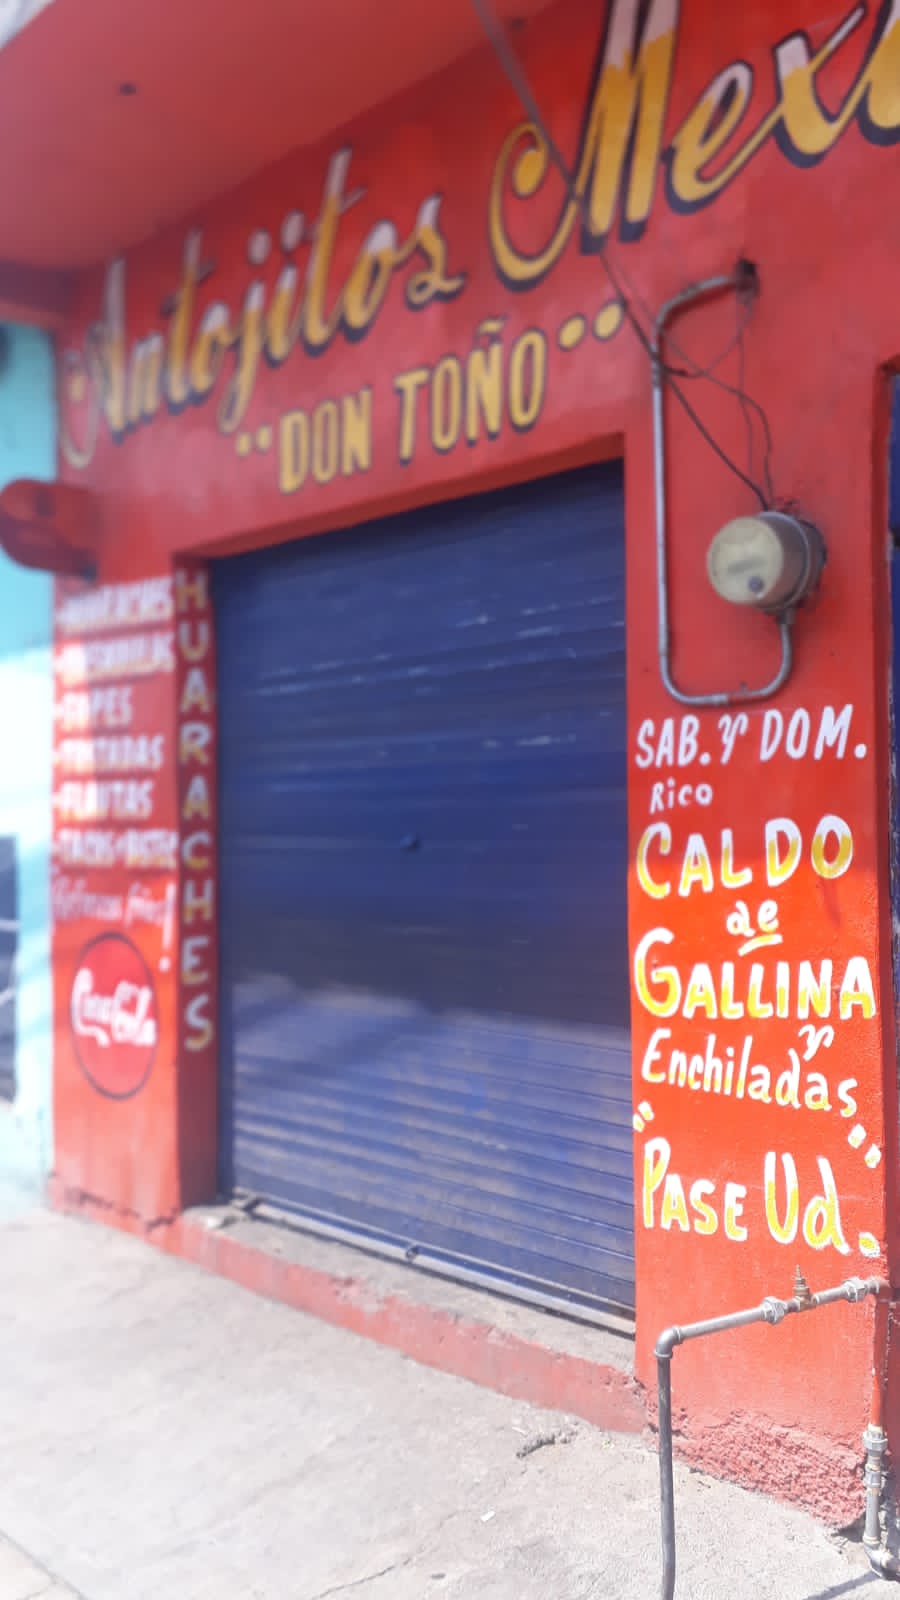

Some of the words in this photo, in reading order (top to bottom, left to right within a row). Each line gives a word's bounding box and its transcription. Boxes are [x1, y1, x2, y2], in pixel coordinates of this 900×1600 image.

[60, 145, 467, 470] Antojitos
[278, 387, 373, 494] DON
[394, 317, 548, 463] TOÑO
[635, 717, 711, 769] SAB.
[759, 703, 868, 763] DOM.
[174, 570, 214, 1052] HUARACHES
[636, 813, 853, 899] CALDO
[726, 900, 780, 940] de
[633, 926, 877, 1020] GALLINA
[640, 1027, 858, 1118] Enchiladas
